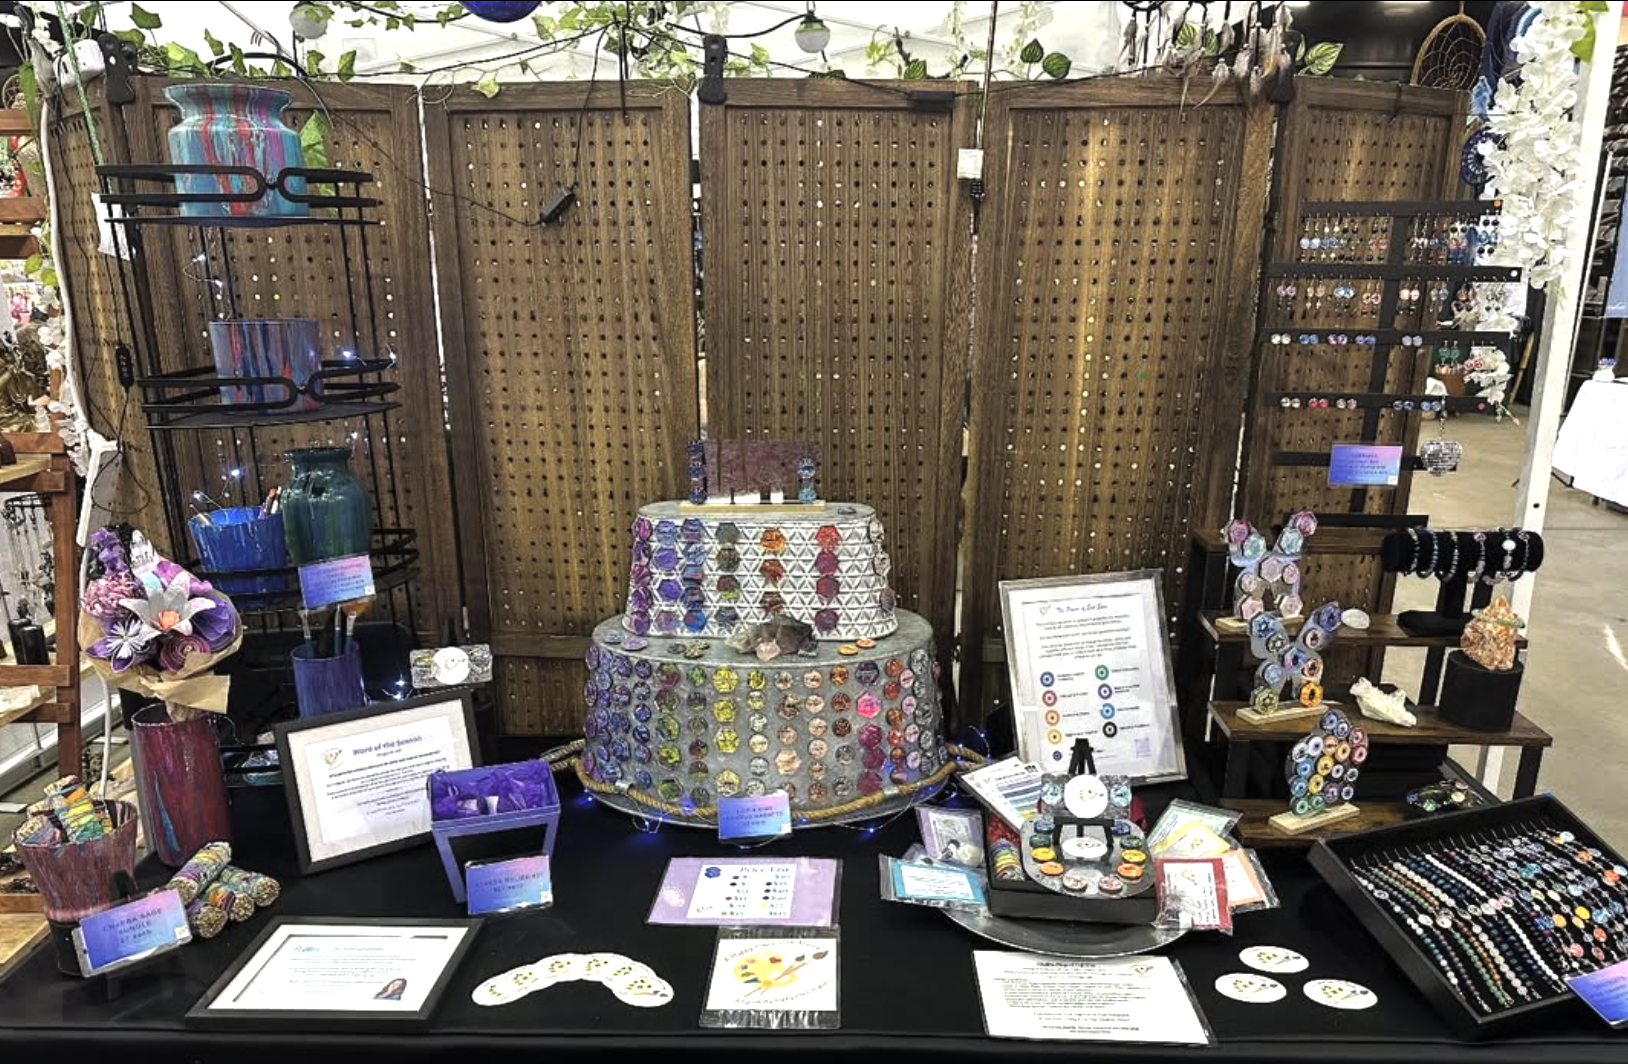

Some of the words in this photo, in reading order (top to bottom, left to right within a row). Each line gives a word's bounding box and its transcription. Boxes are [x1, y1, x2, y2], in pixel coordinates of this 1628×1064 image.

[352, 745, 373, 756] Word
[374, 742, 381, 751] of
[382, 740, 395, 749] the
[396, 735, 423, 748] Season
[103, 917, 138, 932] CHAKRA
[140, 907, 163, 919] SAGE
[118, 920, 152, 935] BUNDLE
